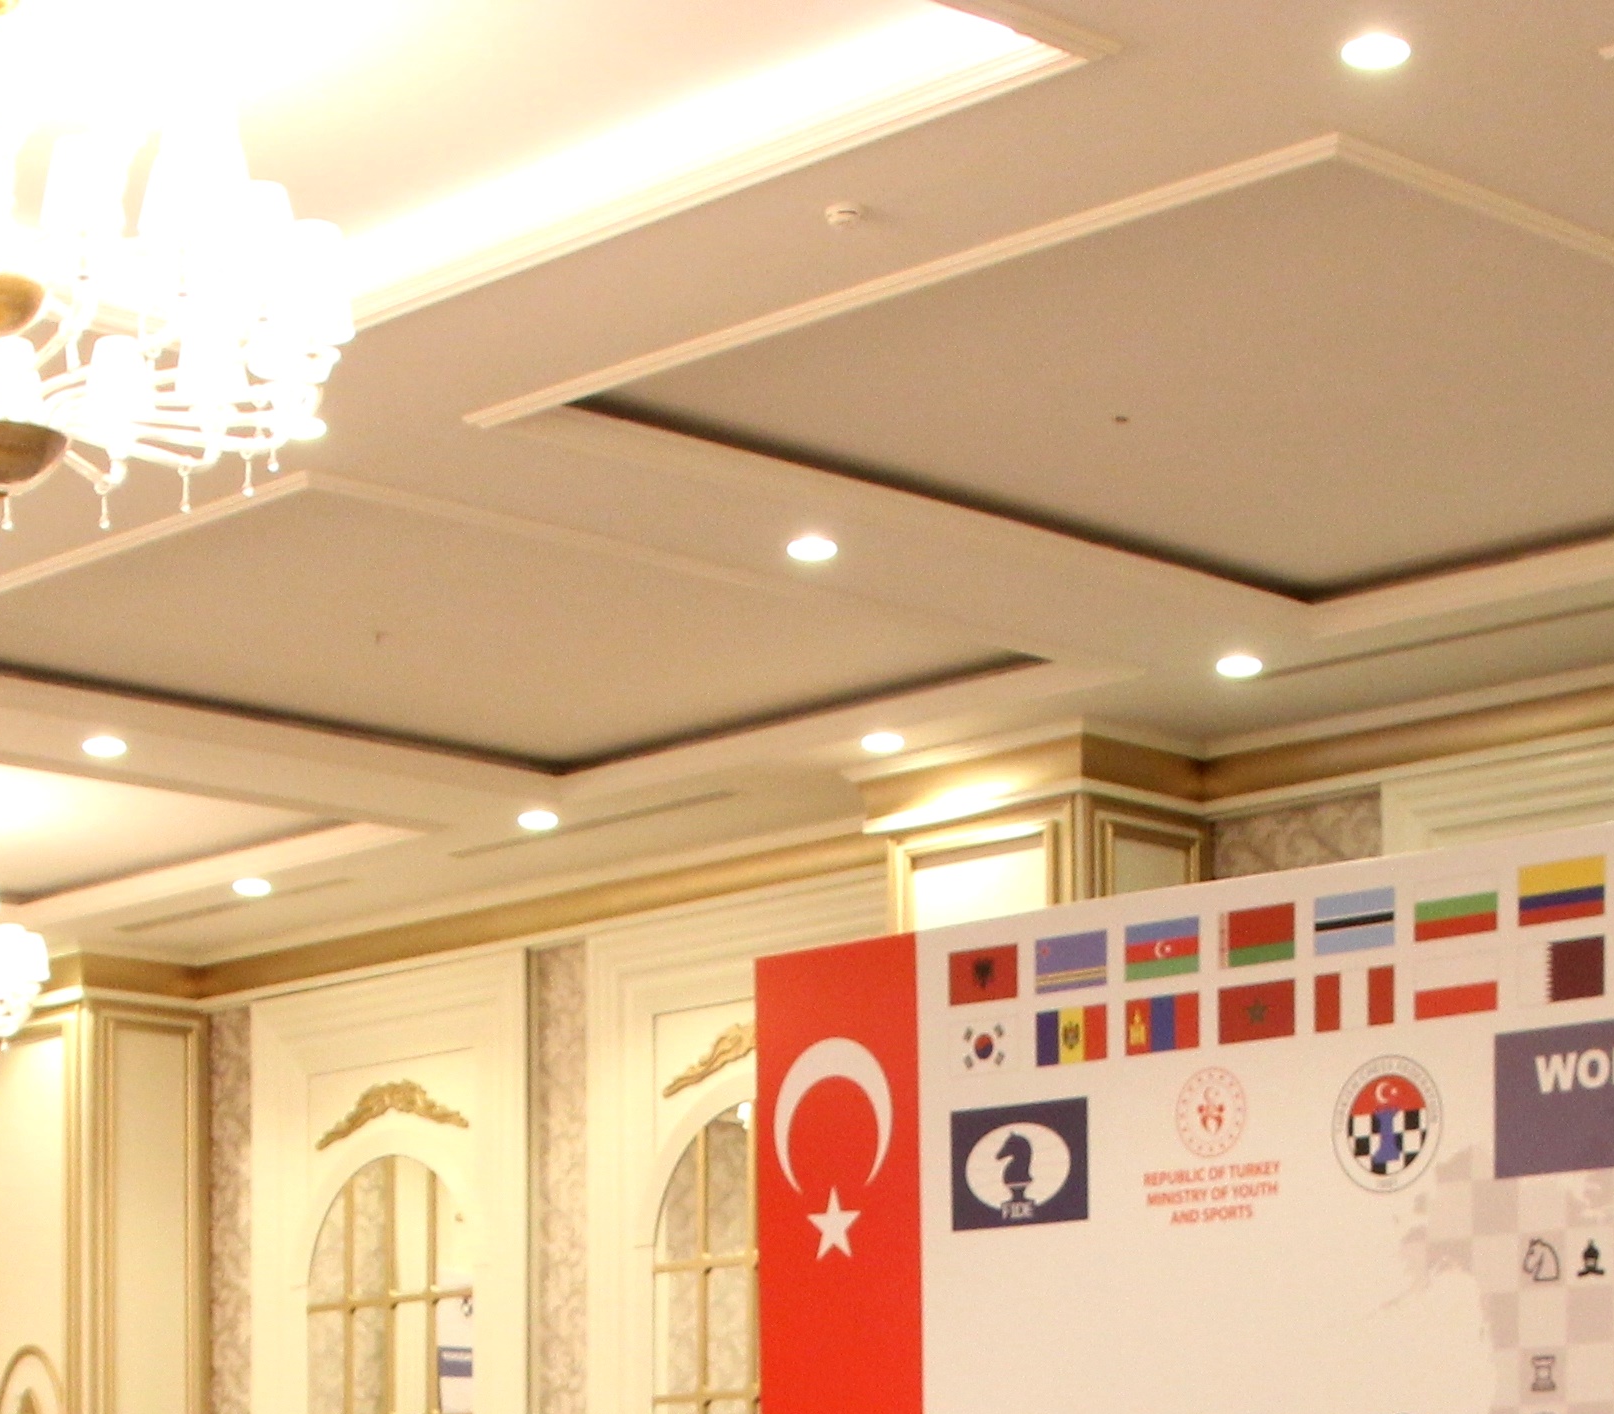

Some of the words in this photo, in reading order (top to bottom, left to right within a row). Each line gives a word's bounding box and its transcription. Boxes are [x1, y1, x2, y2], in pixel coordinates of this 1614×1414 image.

[1144, 1167, 1204, 1186] REPUBLIC
[1208, 1166, 1225, 1180] OF
[1230, 1160, 1280, 1178] TURKEY
[1147, 1189, 1207, 1206] MINISTRY
[1211, 1186, 1227, 1200] OF
[1233, 1181, 1278, 1198] YOUTH
[1001, 1200, 1034, 1219] FIDE
[1171, 1209, 1199, 1225] AND
[1203, 1204, 1253, 1222] SPORTS
